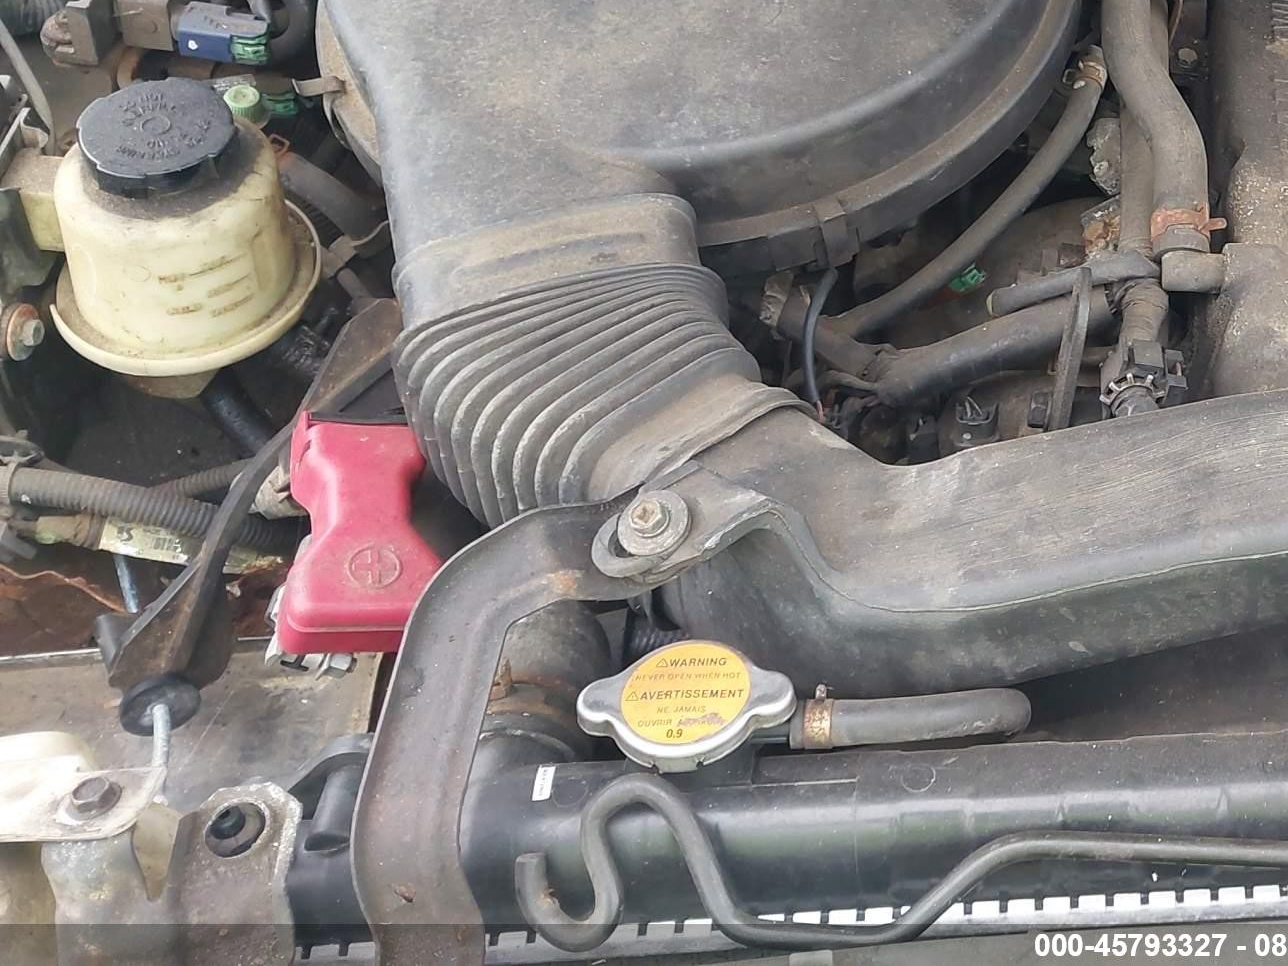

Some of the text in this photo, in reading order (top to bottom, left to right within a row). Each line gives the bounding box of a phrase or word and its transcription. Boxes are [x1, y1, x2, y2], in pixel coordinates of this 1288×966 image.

[669, 657, 727, 667] WARNING
[636, 673, 664, 681] NEVER
[667, 673, 692, 681] OPEN
[640, 689, 744, 701] AVERTISSEMENT
[657, 706, 670, 714] NE
[637, 719, 673, 727] OUVRIR
[666, 729, 683, 738] 0.9
